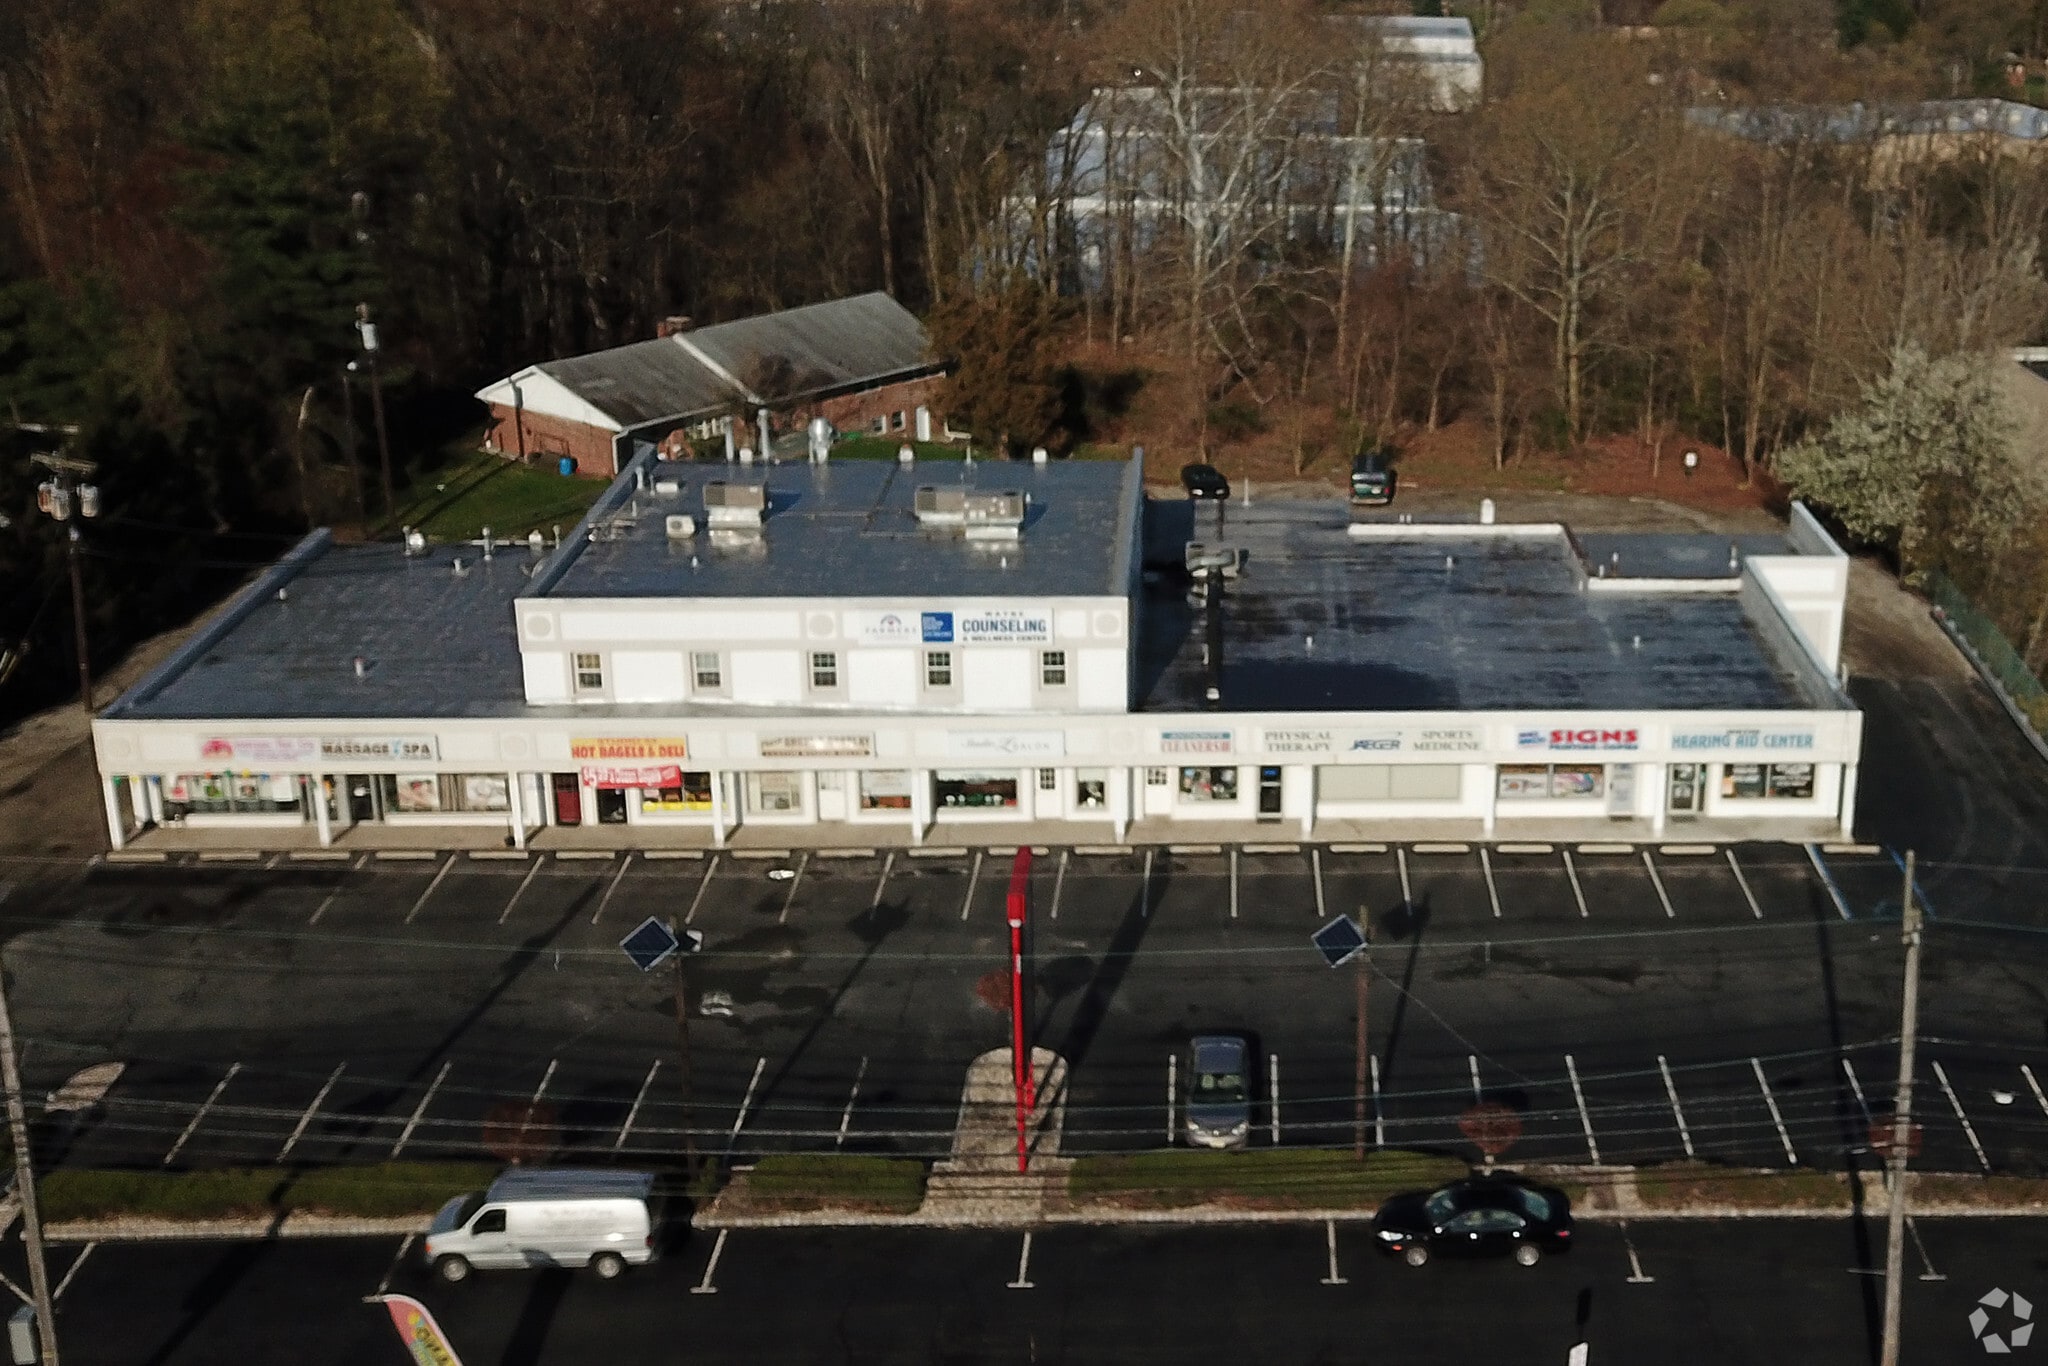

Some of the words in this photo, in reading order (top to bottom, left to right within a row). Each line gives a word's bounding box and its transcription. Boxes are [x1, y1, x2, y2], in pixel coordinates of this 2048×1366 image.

[962, 619, 1047, 632] COUNSELING
[1265, 731, 1332, 741] PHYSICAL
[1422, 731, 1473, 739] SPORTS
[1550, 730, 1638, 743] SIGNS
[1268, 742, 1331, 751] THERAPY
[1414, 742, 1481, 751] MEDICINE
[1671, 735, 1731, 748] HEARING
[1735, 735, 1759, 748] AID
[1763, 735, 1814, 748] CENTER
[321, 744, 389, 754] MASSAGE
[402, 744, 431, 754] SPA
[571, 746, 596, 758] HOT
[599, 746, 645, 758] BAGELS
[658, 745, 685, 757] DELI
